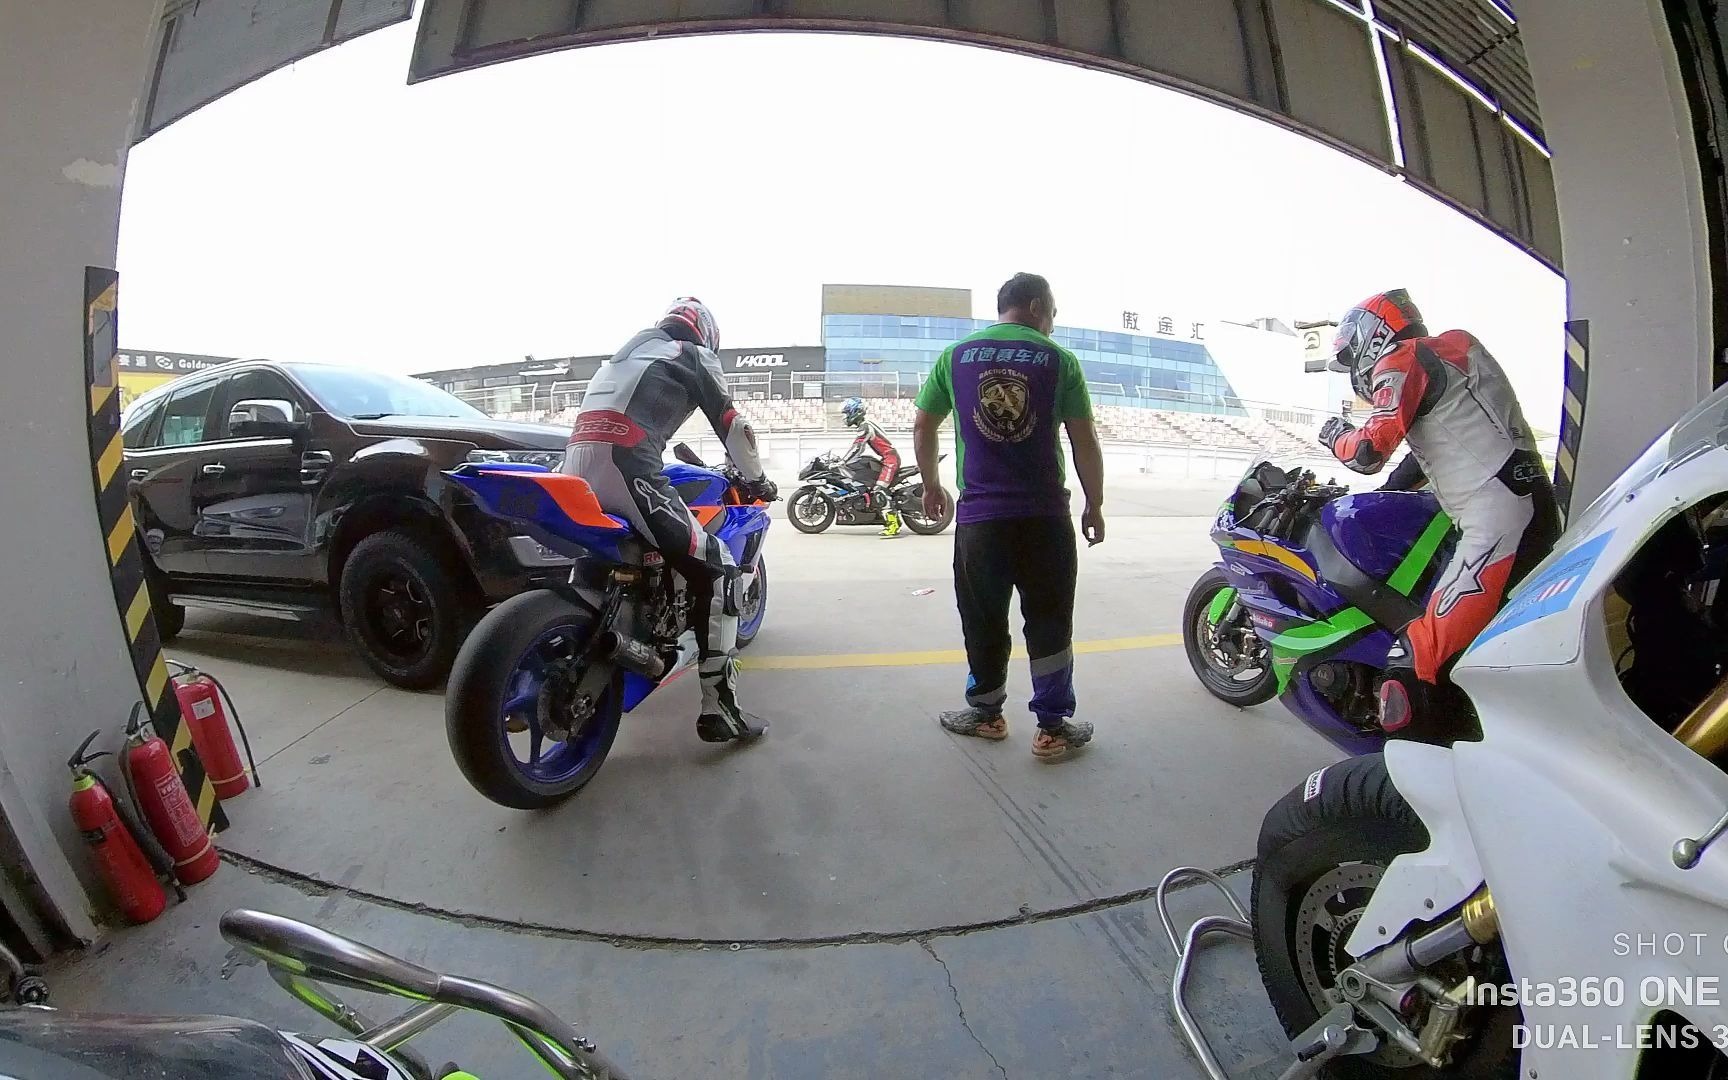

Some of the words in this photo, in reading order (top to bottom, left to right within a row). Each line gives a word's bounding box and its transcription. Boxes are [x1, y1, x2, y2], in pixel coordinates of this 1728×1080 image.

[1122, 310, 1204, 340] 傲途汇
[1007, 368, 1028, 381] TEAM
